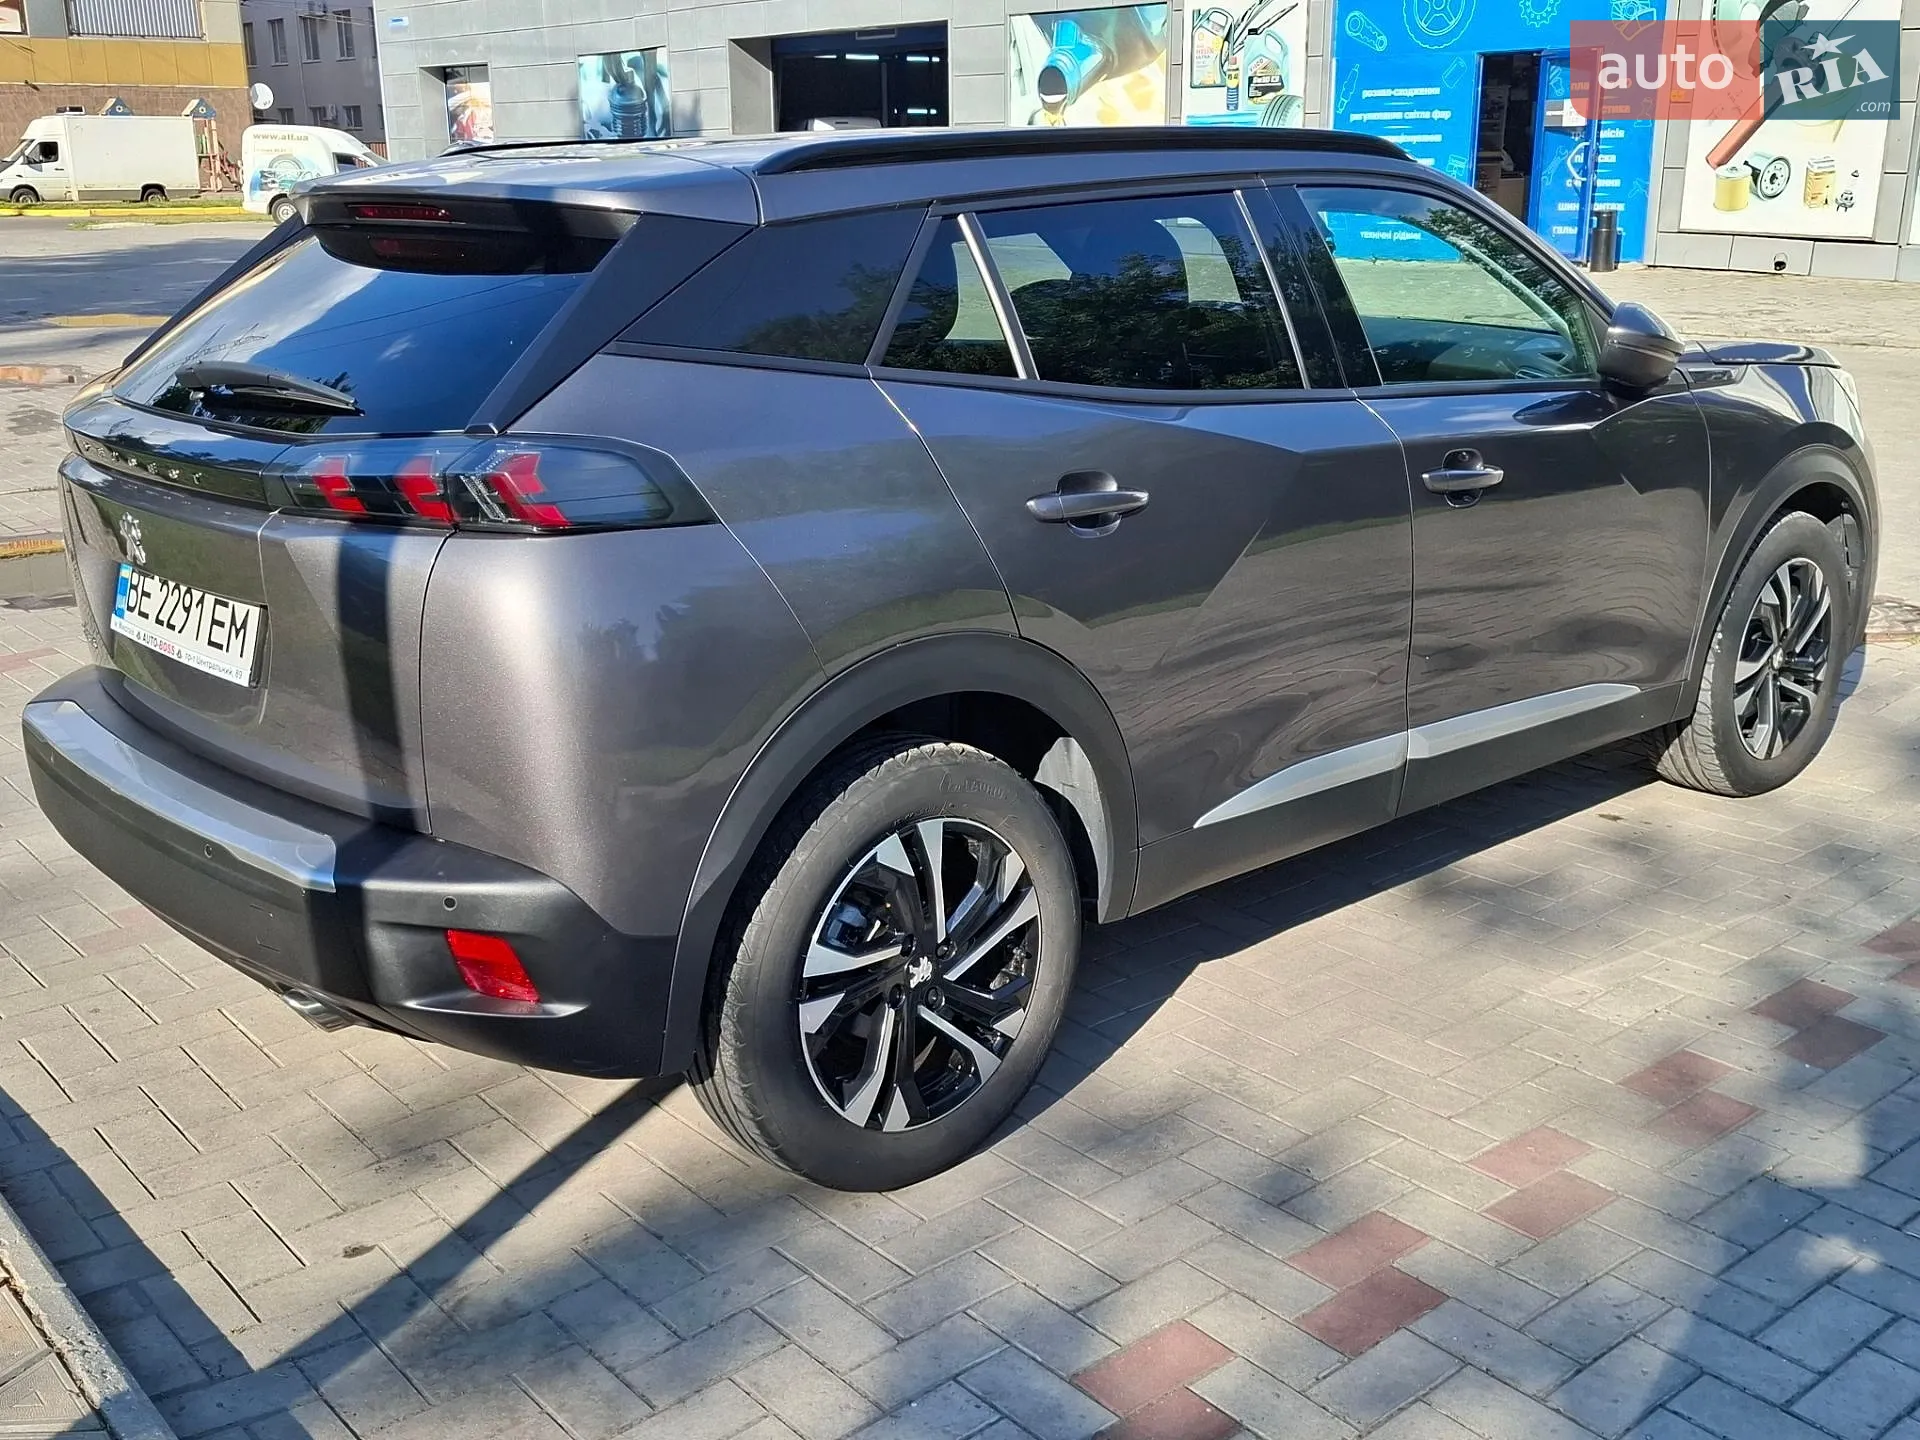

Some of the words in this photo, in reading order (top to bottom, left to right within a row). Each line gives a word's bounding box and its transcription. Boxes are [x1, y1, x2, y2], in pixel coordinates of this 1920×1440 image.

[126, 570, 155, 620] BE
[155, 578, 206, 642] 2291
[207, 597, 250, 658] EM
